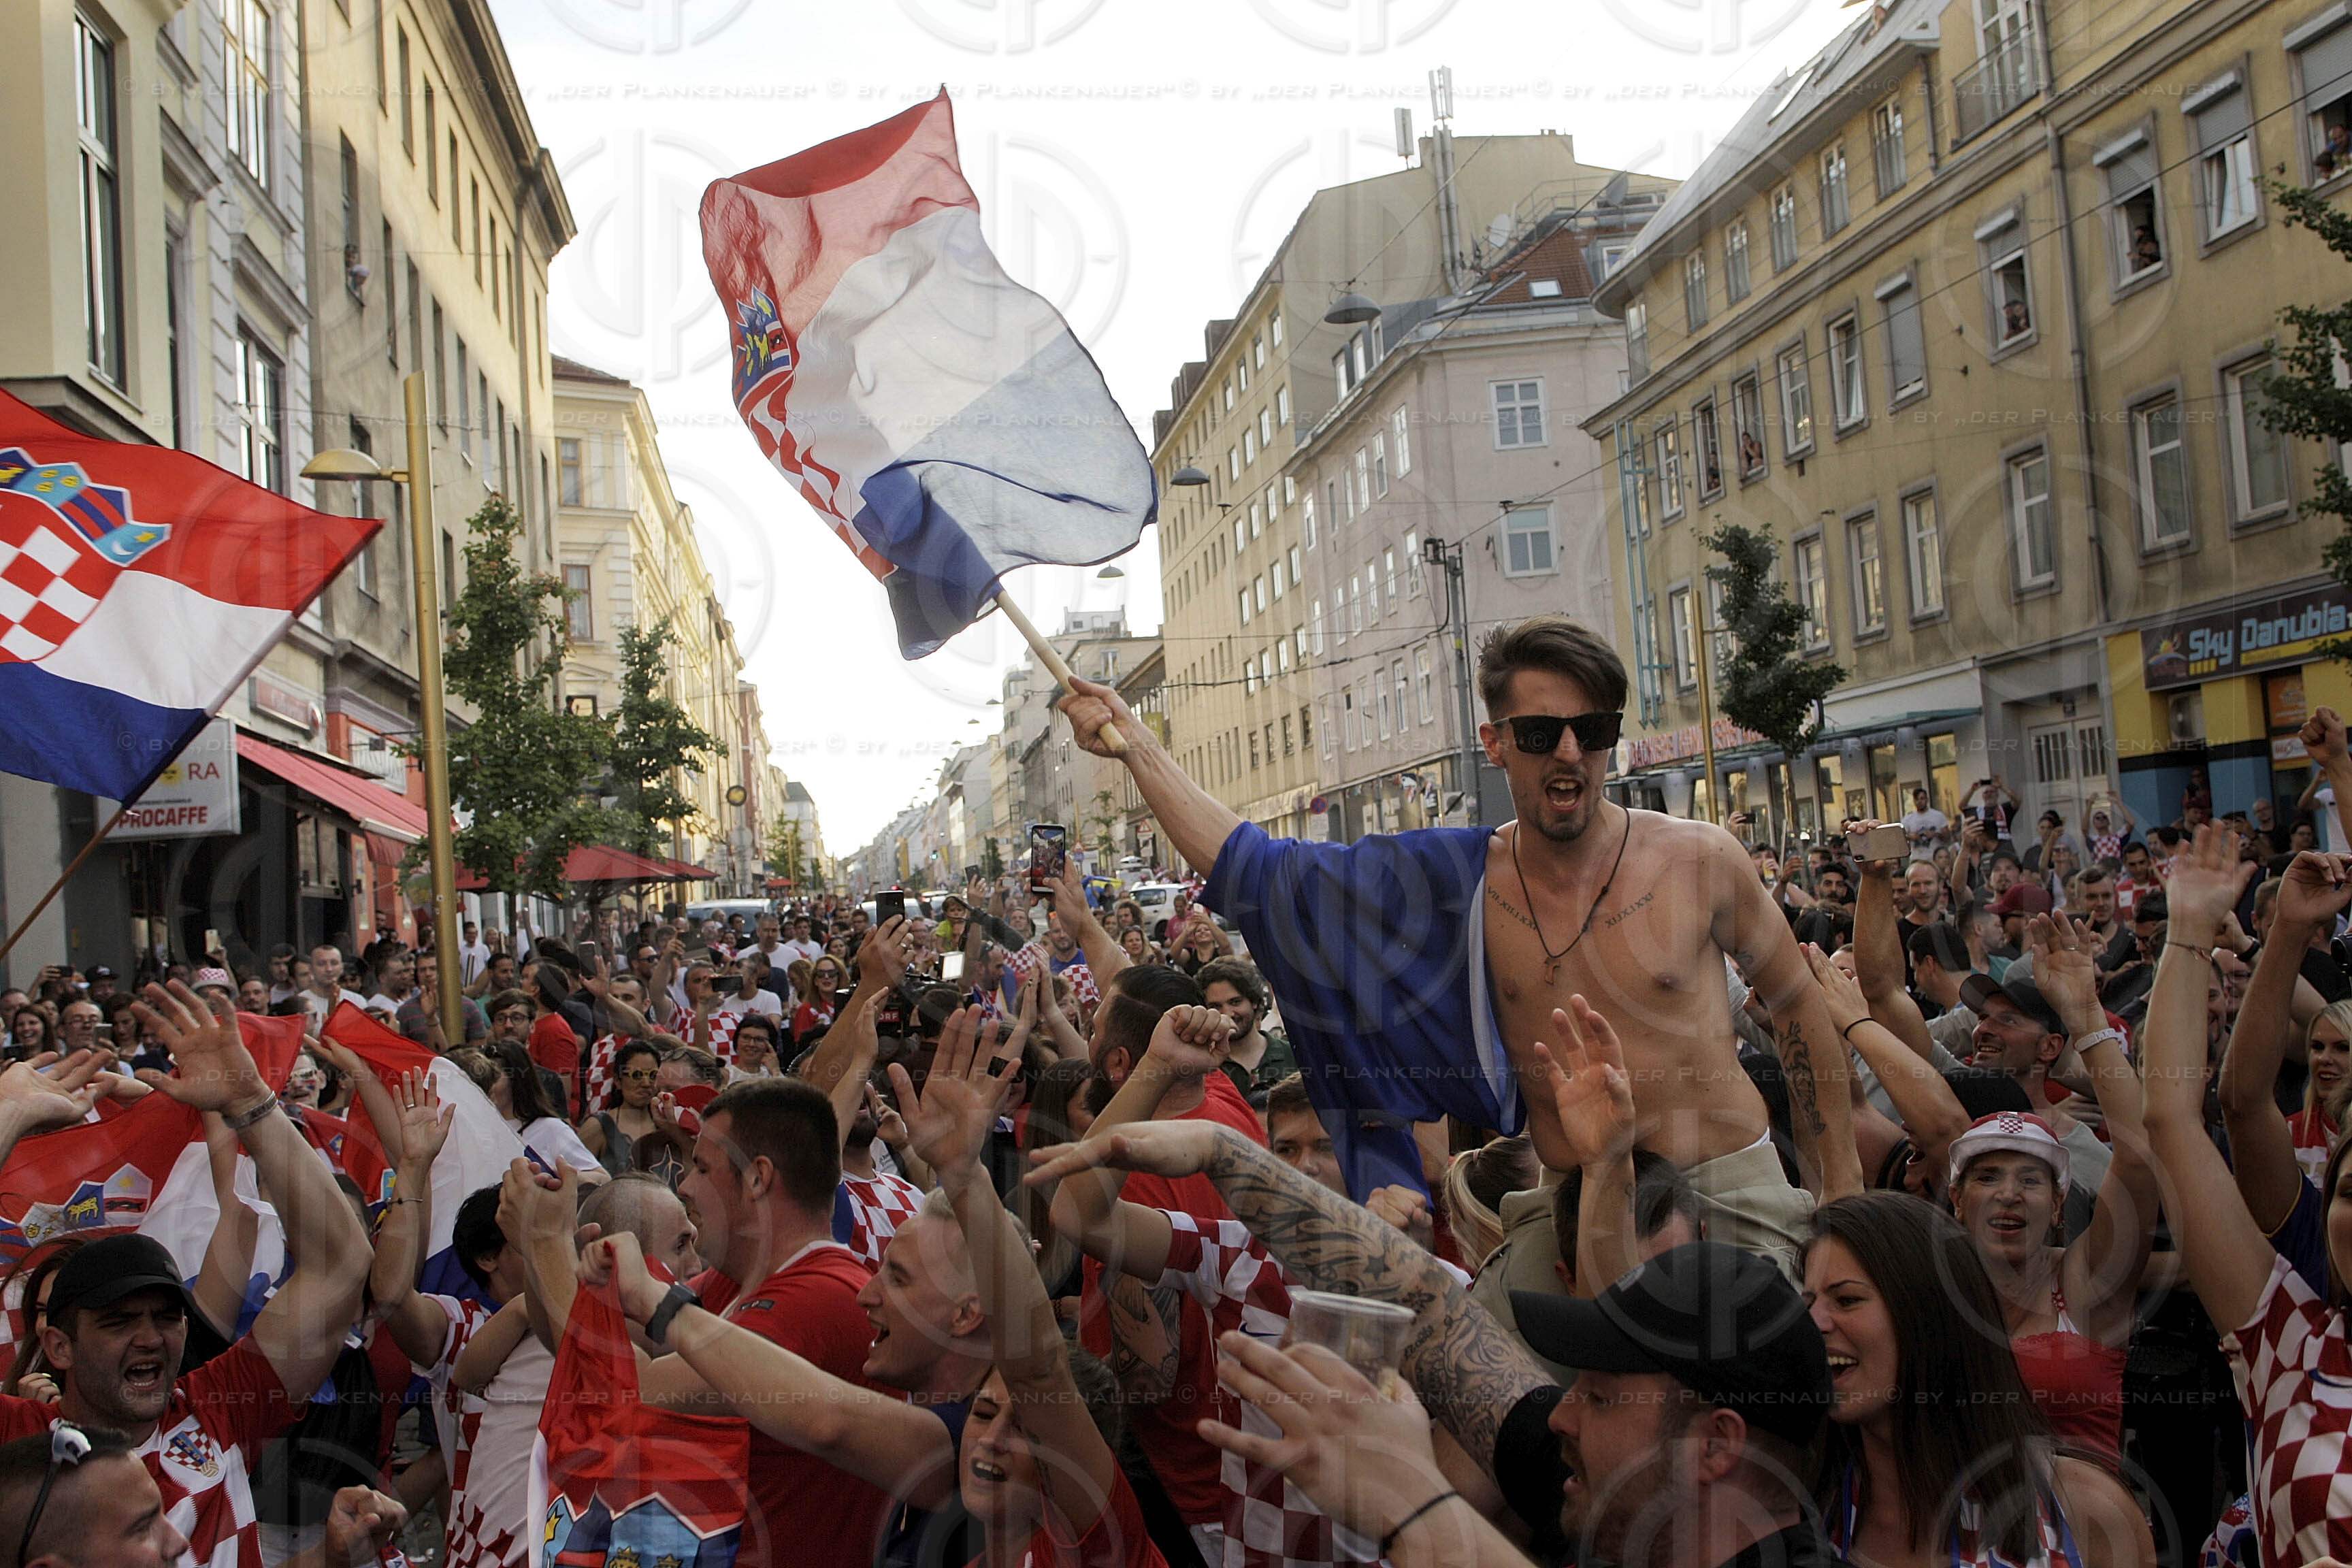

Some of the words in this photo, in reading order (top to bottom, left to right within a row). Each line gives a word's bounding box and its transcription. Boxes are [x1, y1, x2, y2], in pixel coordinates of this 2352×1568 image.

[2188, 627, 2233, 666] Sky
[188, 762, 219, 780] RA
[118, 806, 208, 828] PROCAFFE
